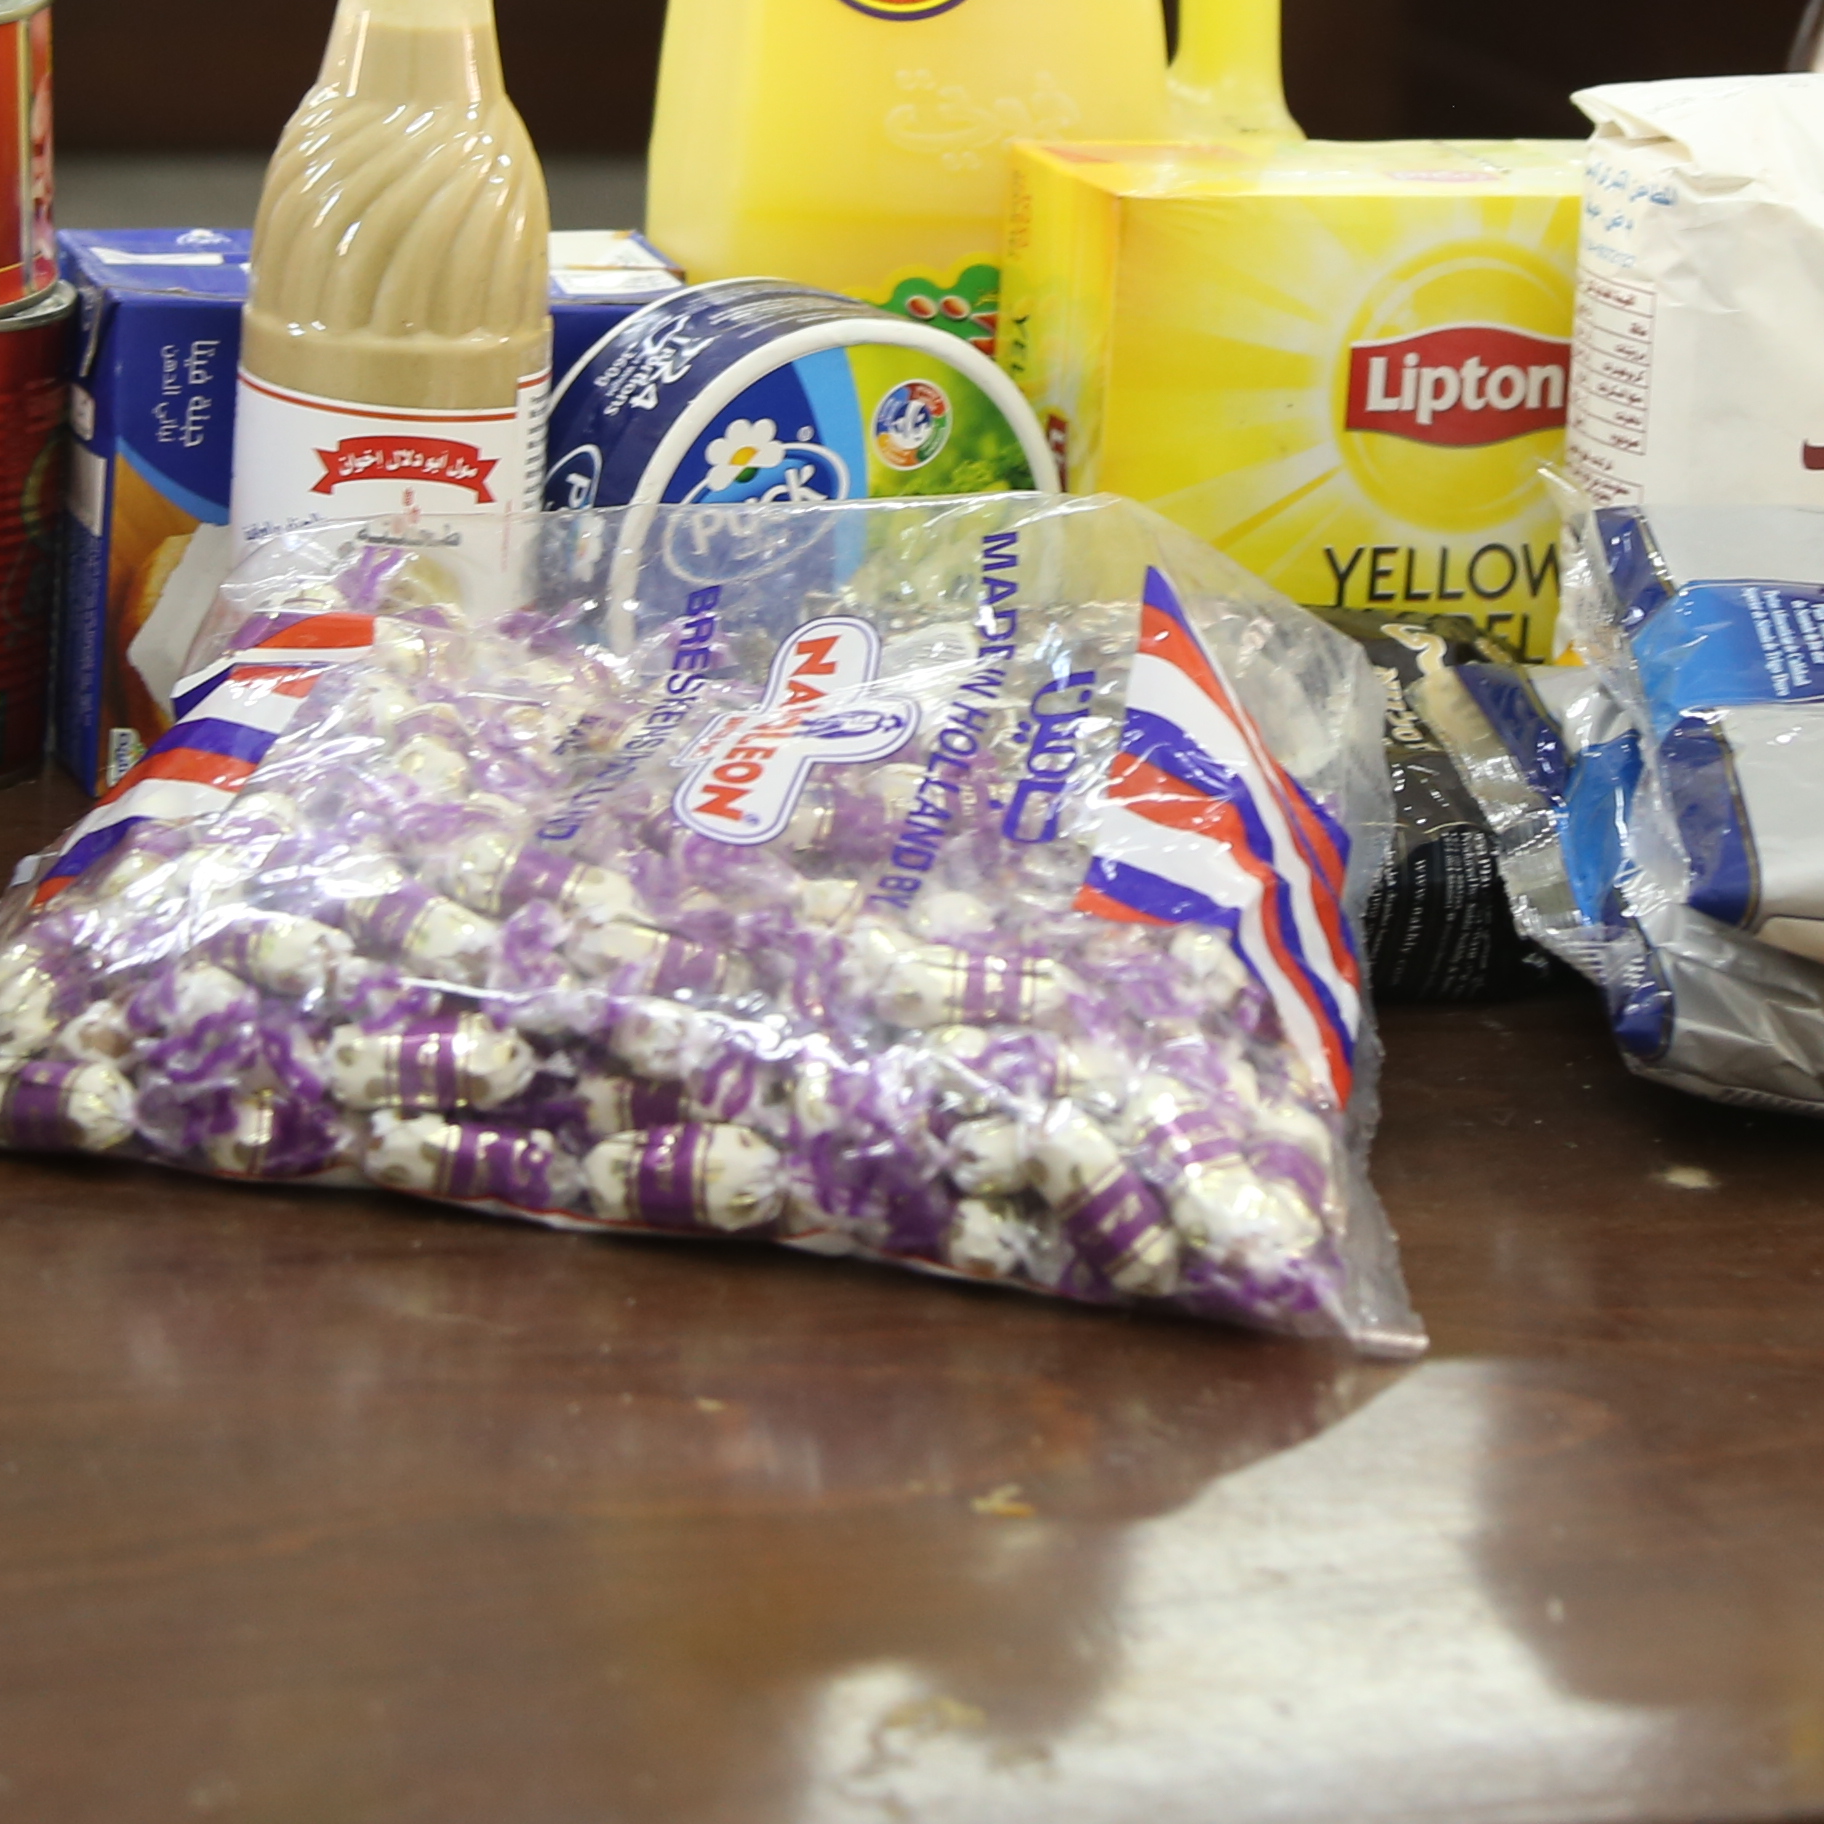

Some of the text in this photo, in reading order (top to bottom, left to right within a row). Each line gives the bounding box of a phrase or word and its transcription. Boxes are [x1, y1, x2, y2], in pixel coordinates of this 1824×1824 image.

[159, 344, 184, 396] الدهن
[179, 338, 222, 448] جبنة فيتا
[1364, 352, 1565, 426] Lipton
[1325, 542, 1562, 609] YELLOW
[884, 705, 983, 870] HOLLAND
